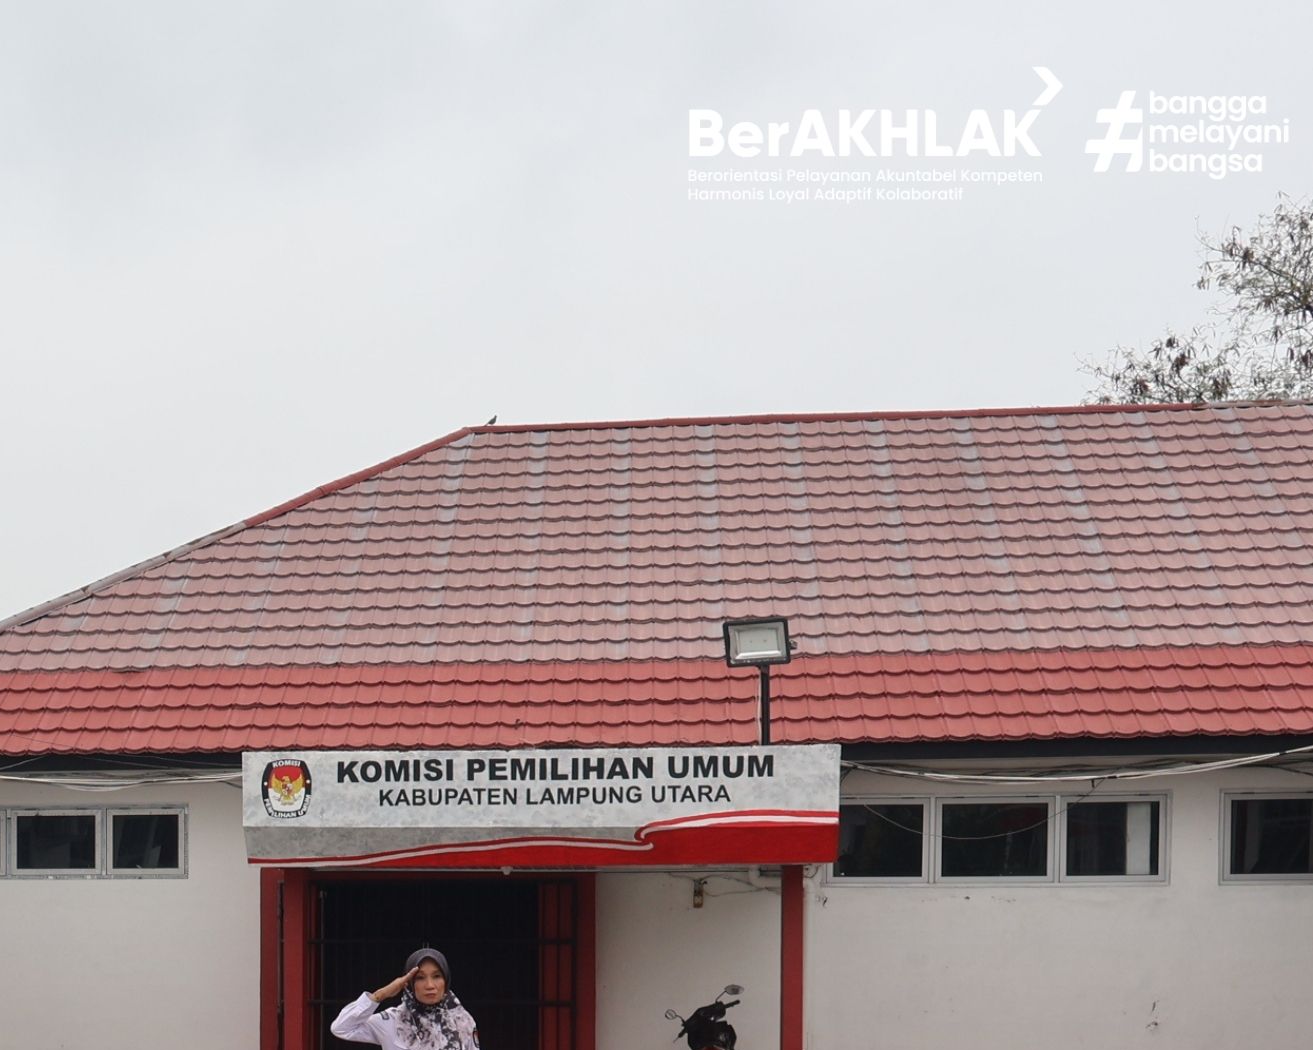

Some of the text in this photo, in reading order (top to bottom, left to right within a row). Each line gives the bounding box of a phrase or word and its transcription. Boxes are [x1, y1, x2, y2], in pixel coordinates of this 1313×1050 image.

[272, 760, 301, 768] KOMISI
[336, 754, 775, 784] KOMISI PEMILIHAN UMUM
[379, 784, 731, 807] KABUPATEN LAMPUNG UTARA
